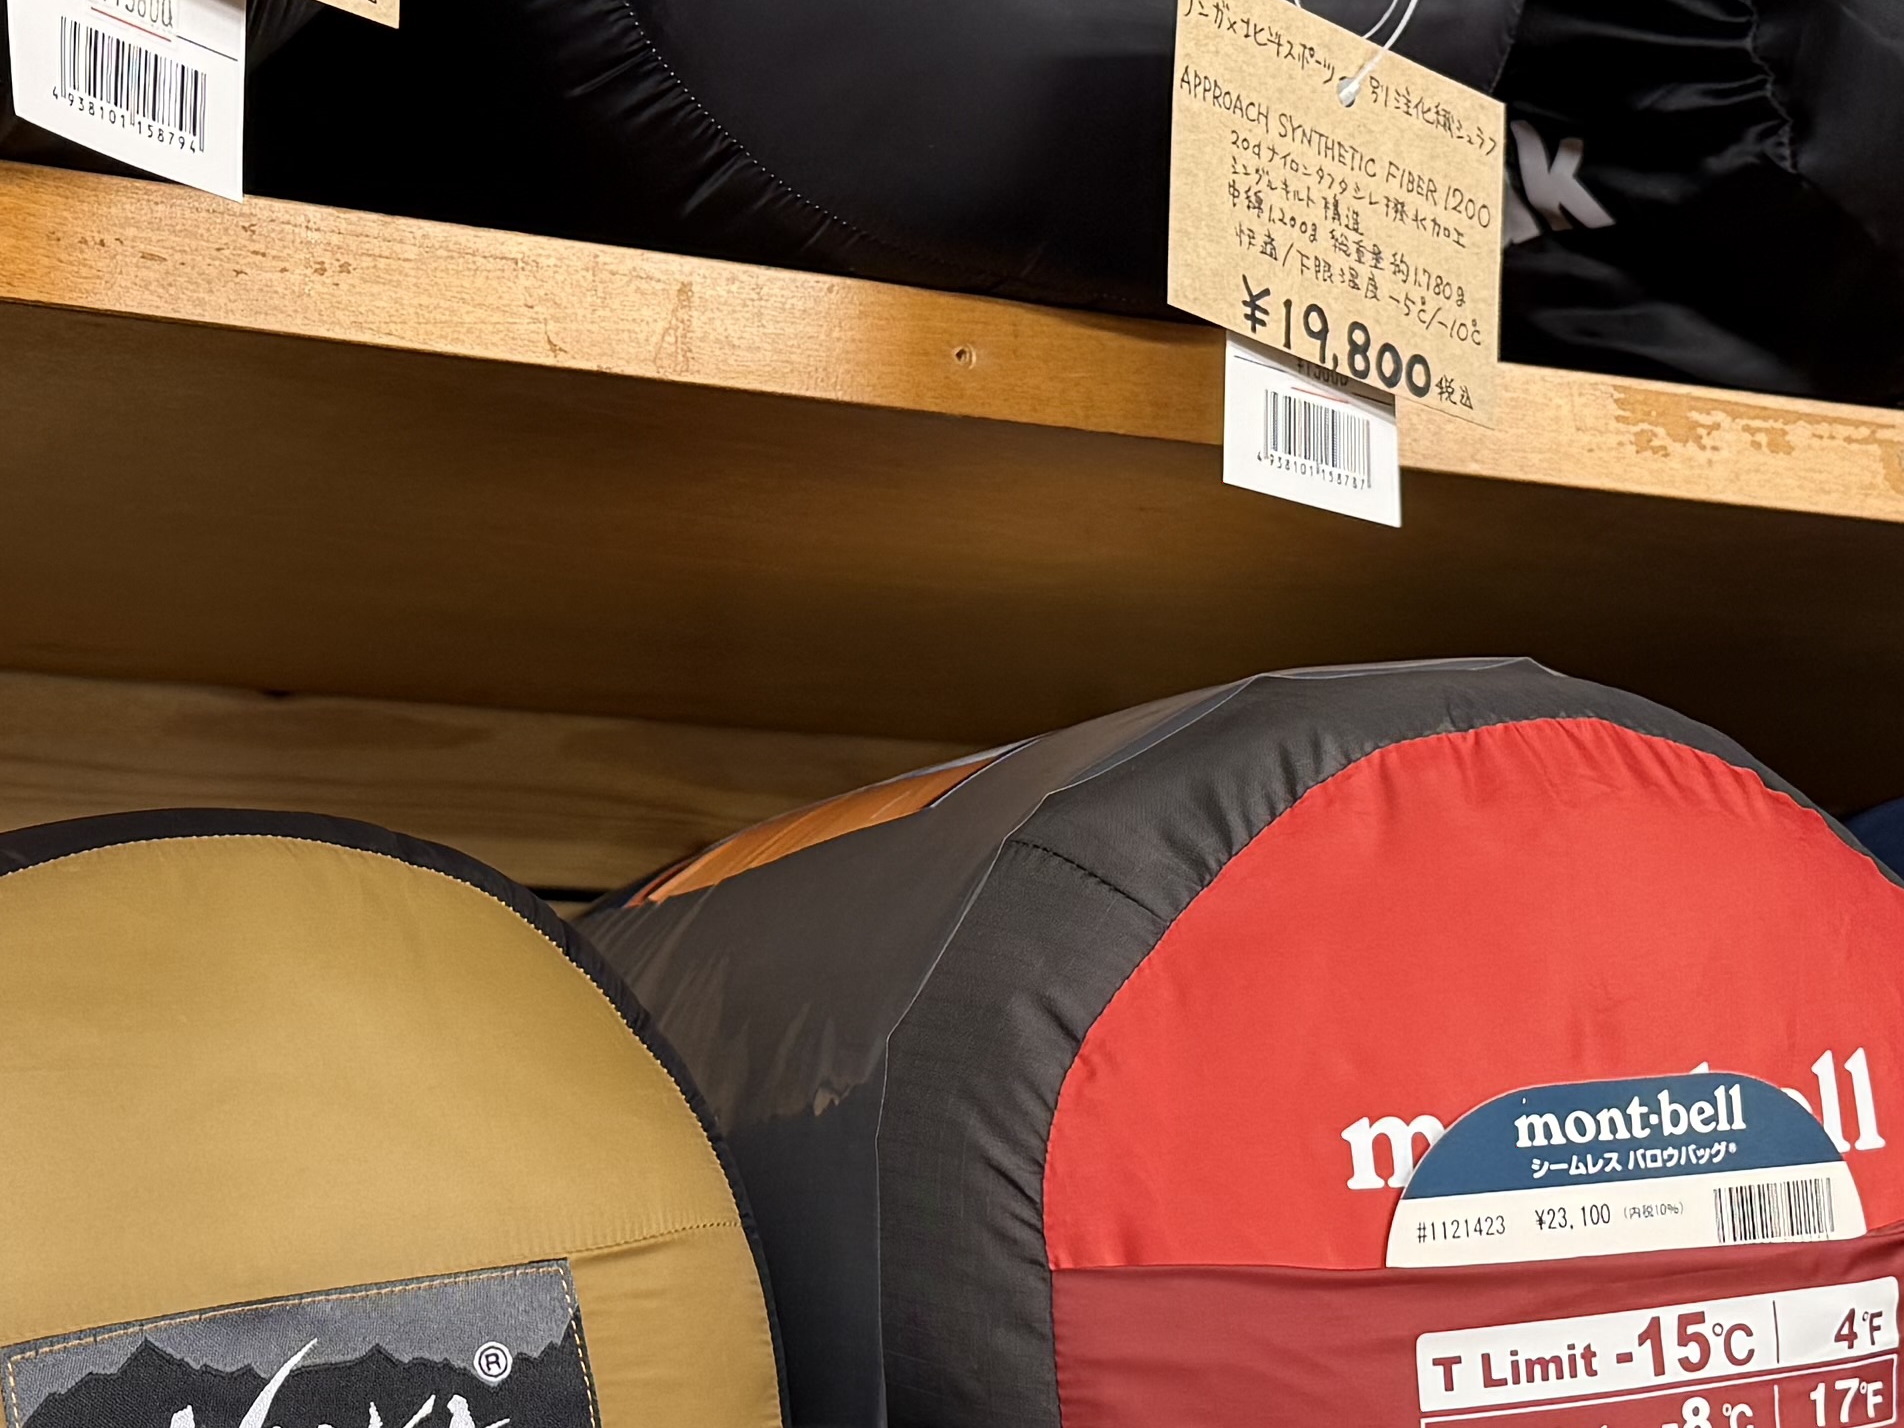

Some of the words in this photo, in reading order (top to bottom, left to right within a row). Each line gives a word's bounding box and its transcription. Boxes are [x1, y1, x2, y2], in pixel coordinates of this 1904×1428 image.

[1180, 64, 1269, 133] APPROACH
[1279, 113, 1377, 177] SYNTHETIC
[1386, 161, 1437, 206] FIBER
[1445, 186, 1491, 228] 1200
[1241, 273, 1432, 398] ¥19,800
[1530, 1152, 1622, 1179] シームレス
[1416, 1213, 1507, 1243] #1121423
[1431, 1356, 1465, 1393] T
[1481, 1344, 1599, 1388] Limit
